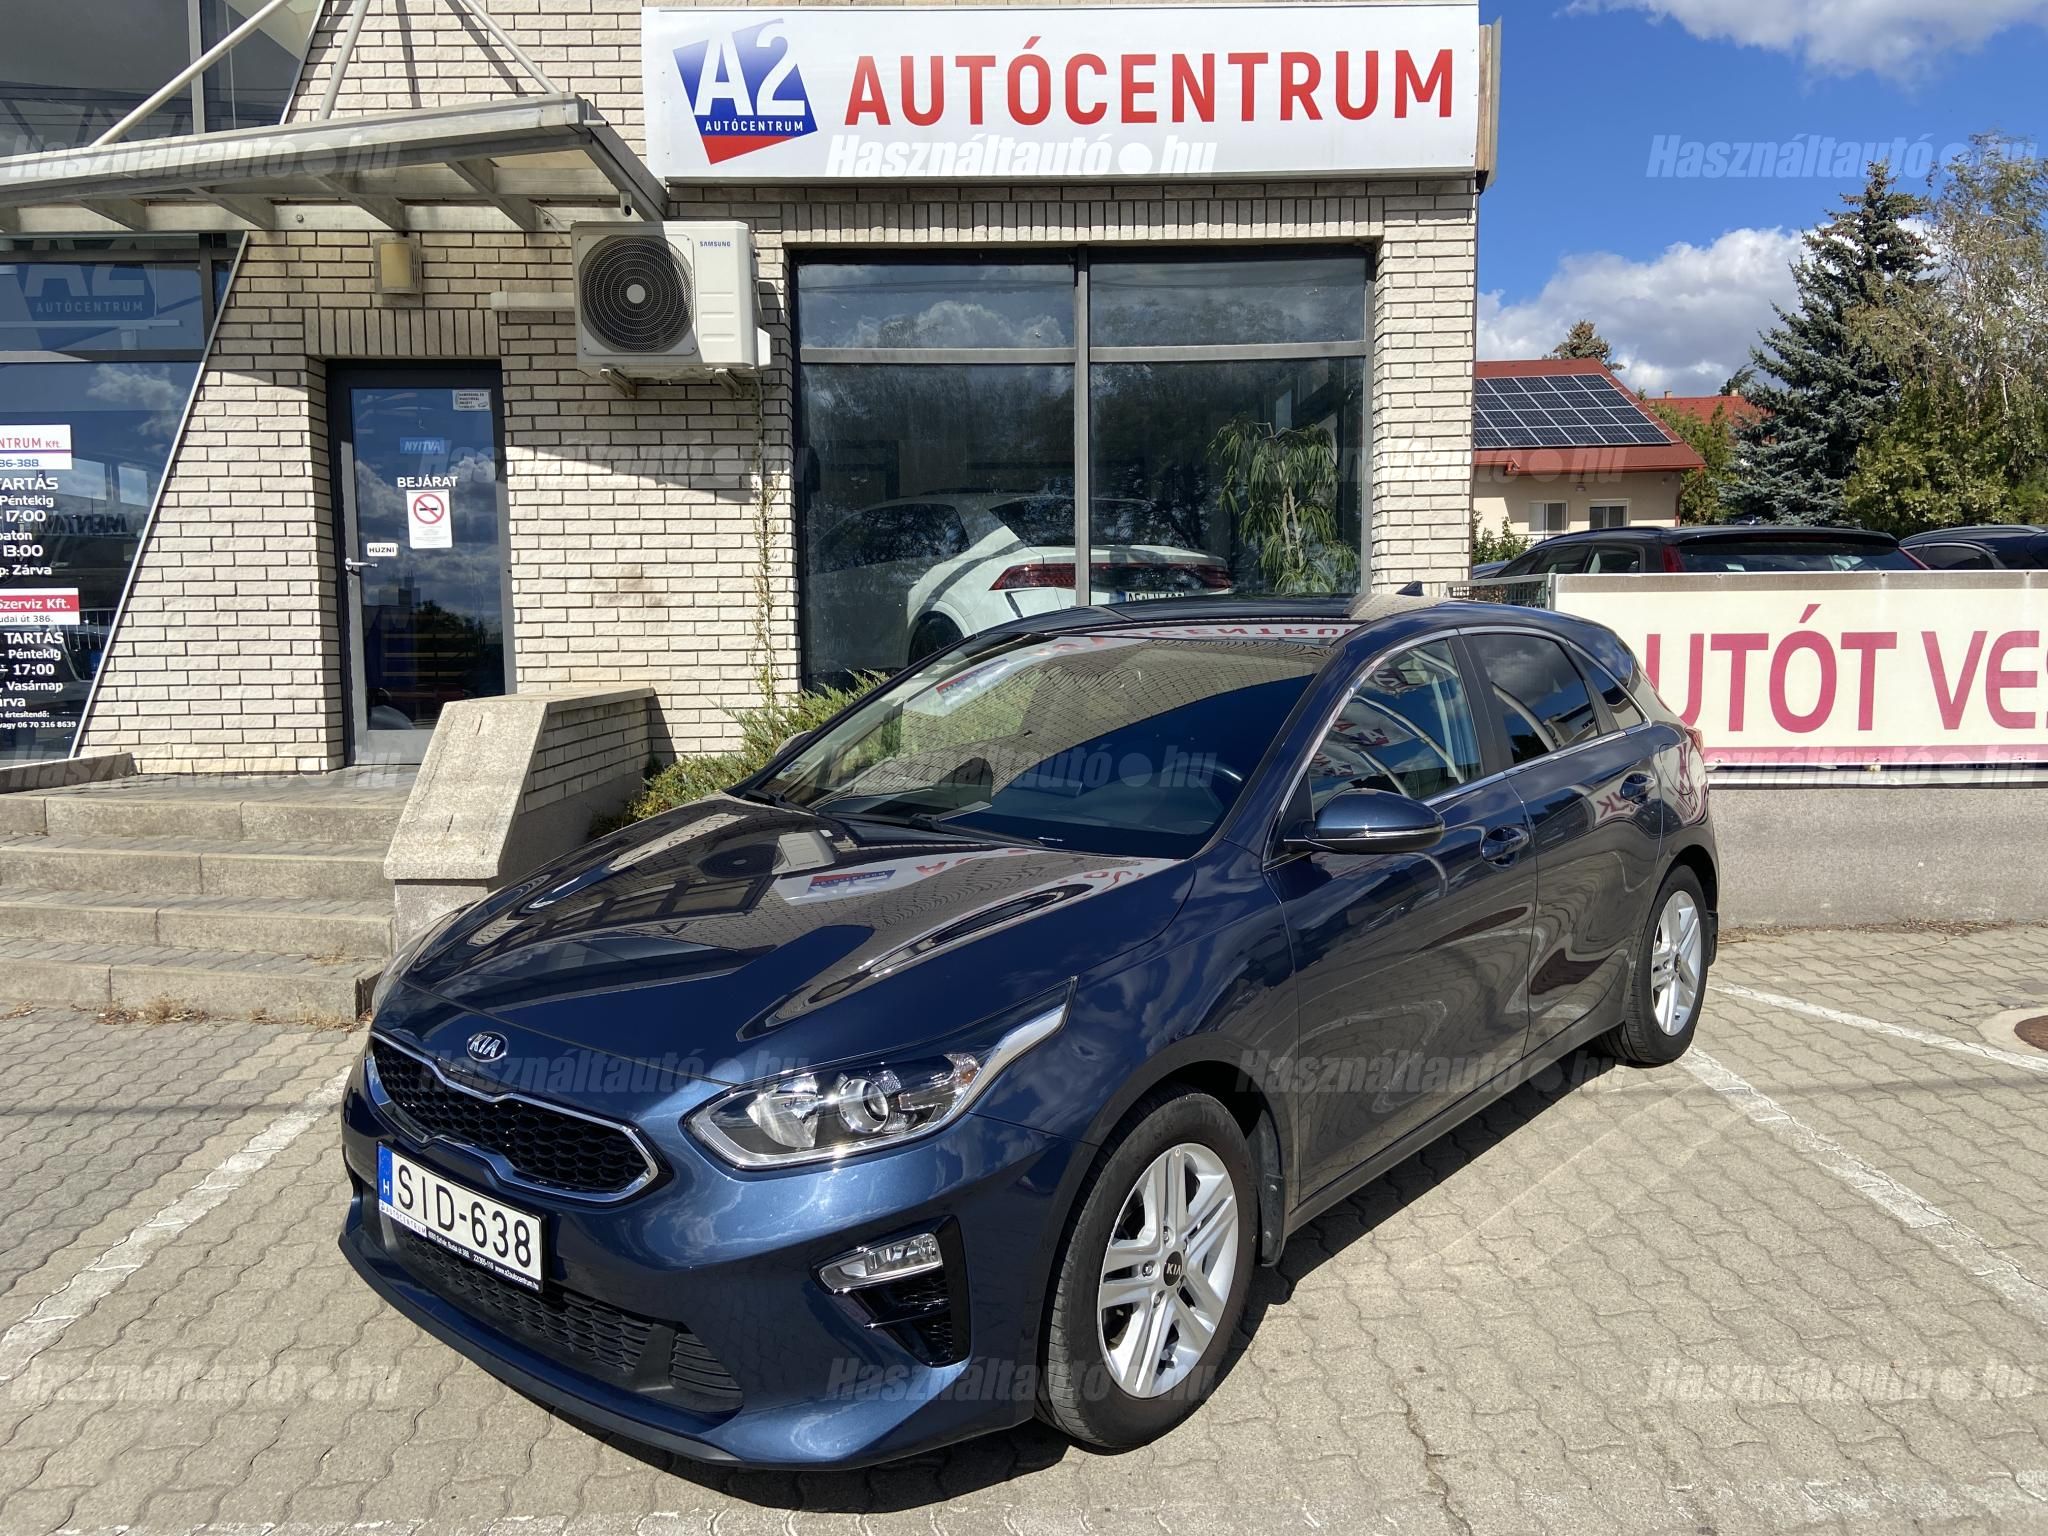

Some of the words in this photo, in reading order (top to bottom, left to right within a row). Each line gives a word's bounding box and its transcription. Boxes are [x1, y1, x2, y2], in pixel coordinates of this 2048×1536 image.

[694, 19, 806, 116] A2
[844, 36, 1453, 126] AUTÓCENTRUM
[704, 119, 804, 132] AUTÓCENTRUM
[0, 474, 58, 490] ARTÁS
[397, 474, 458, 488] BEJÁRAT
[0, 495, 54, 508] Péntekig
[6, 510, 46, 523] 17:00
[3, 545, 43, 557] 13:00
[12, 564, 53, 576] Zárva
[46, 598, 70, 609] Kft.
[4, 628, 64, 645] TARTÁS
[8, 648, 62, 661] Péntekig
[13, 663, 55, 676] 17:00
[1921, 629, 2048, 730] VE
[6, 680, 64, 693] Vasárnap
[41, 720, 55, 728] 316
[56, 720, 77, 728] 8639
[469, 1033, 501, 1058] KIA
[382, 1179, 390, 1196] H
[398, 1164, 531, 1268] SID-638
[1166, 1262, 1183, 1276] KIA
